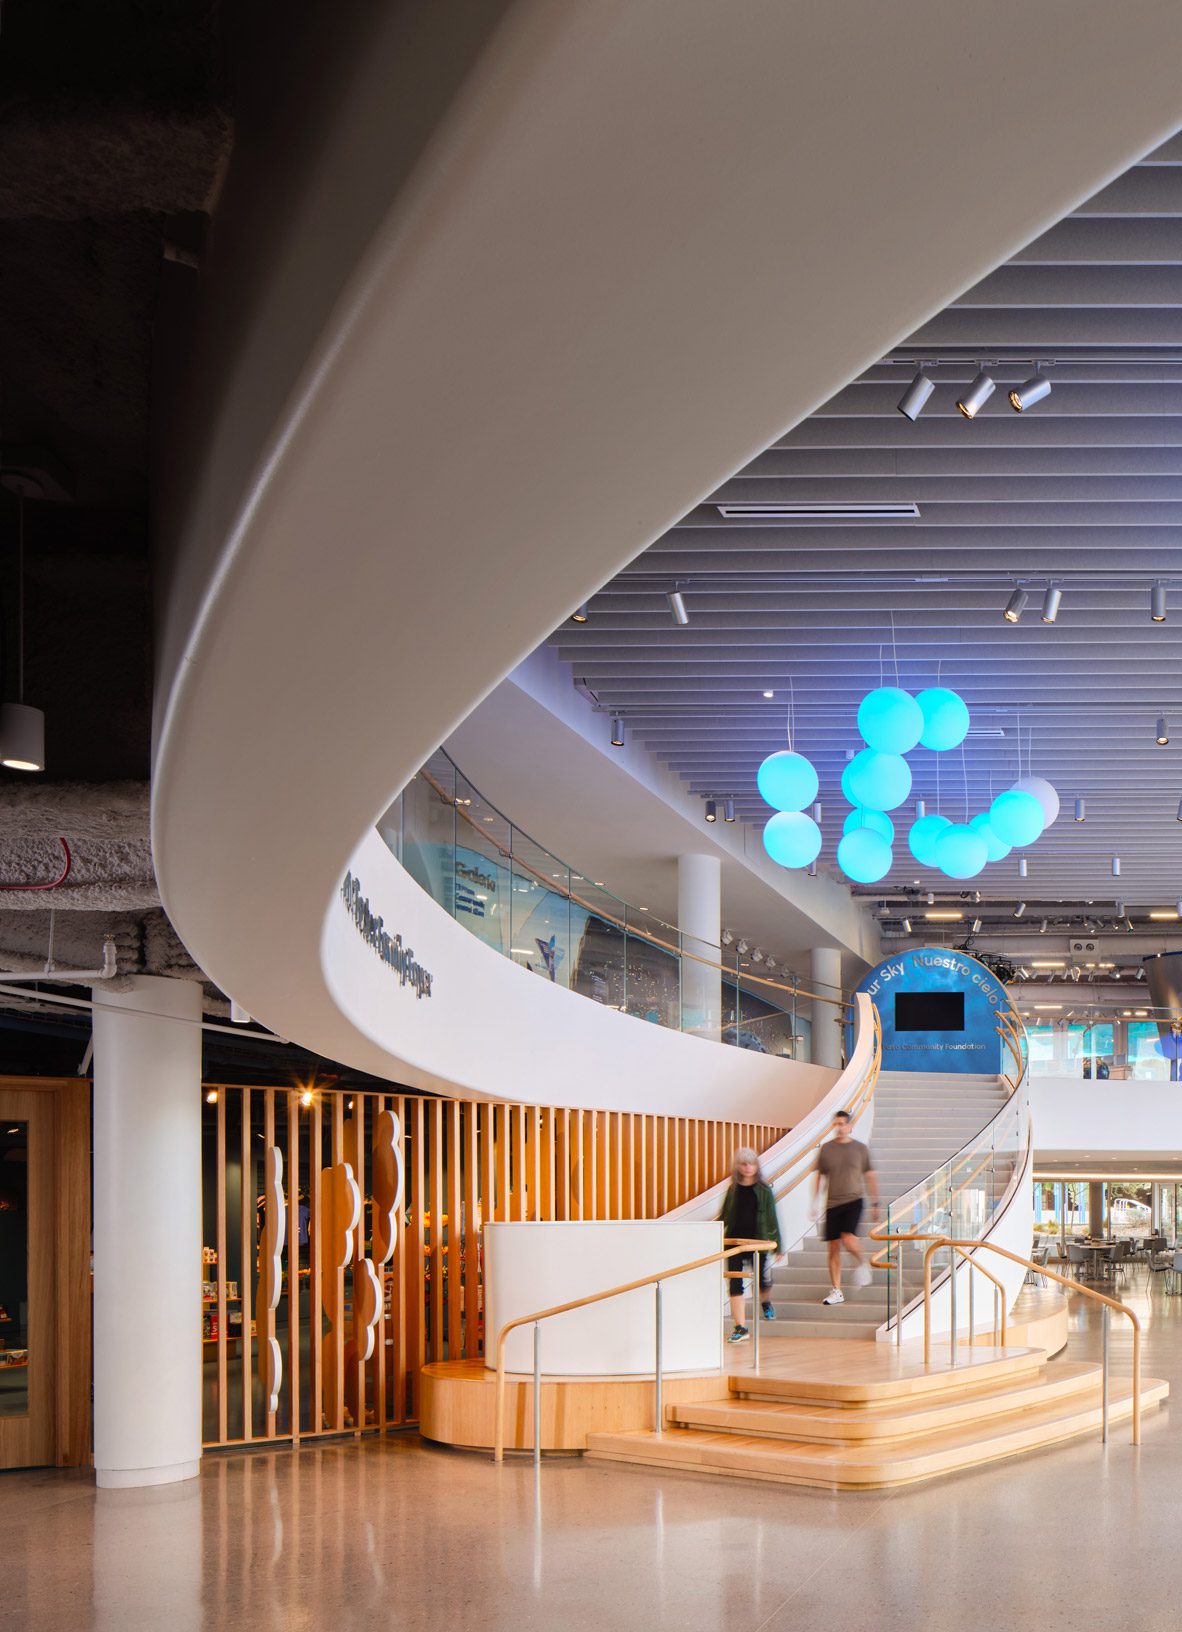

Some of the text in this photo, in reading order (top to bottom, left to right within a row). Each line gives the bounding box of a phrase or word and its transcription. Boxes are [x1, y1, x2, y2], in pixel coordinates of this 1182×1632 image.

[880, 961, 905, 982] Sky
[912, 955, 971, 977] Nuestro
[972, 973, 999, 1005] cielo
